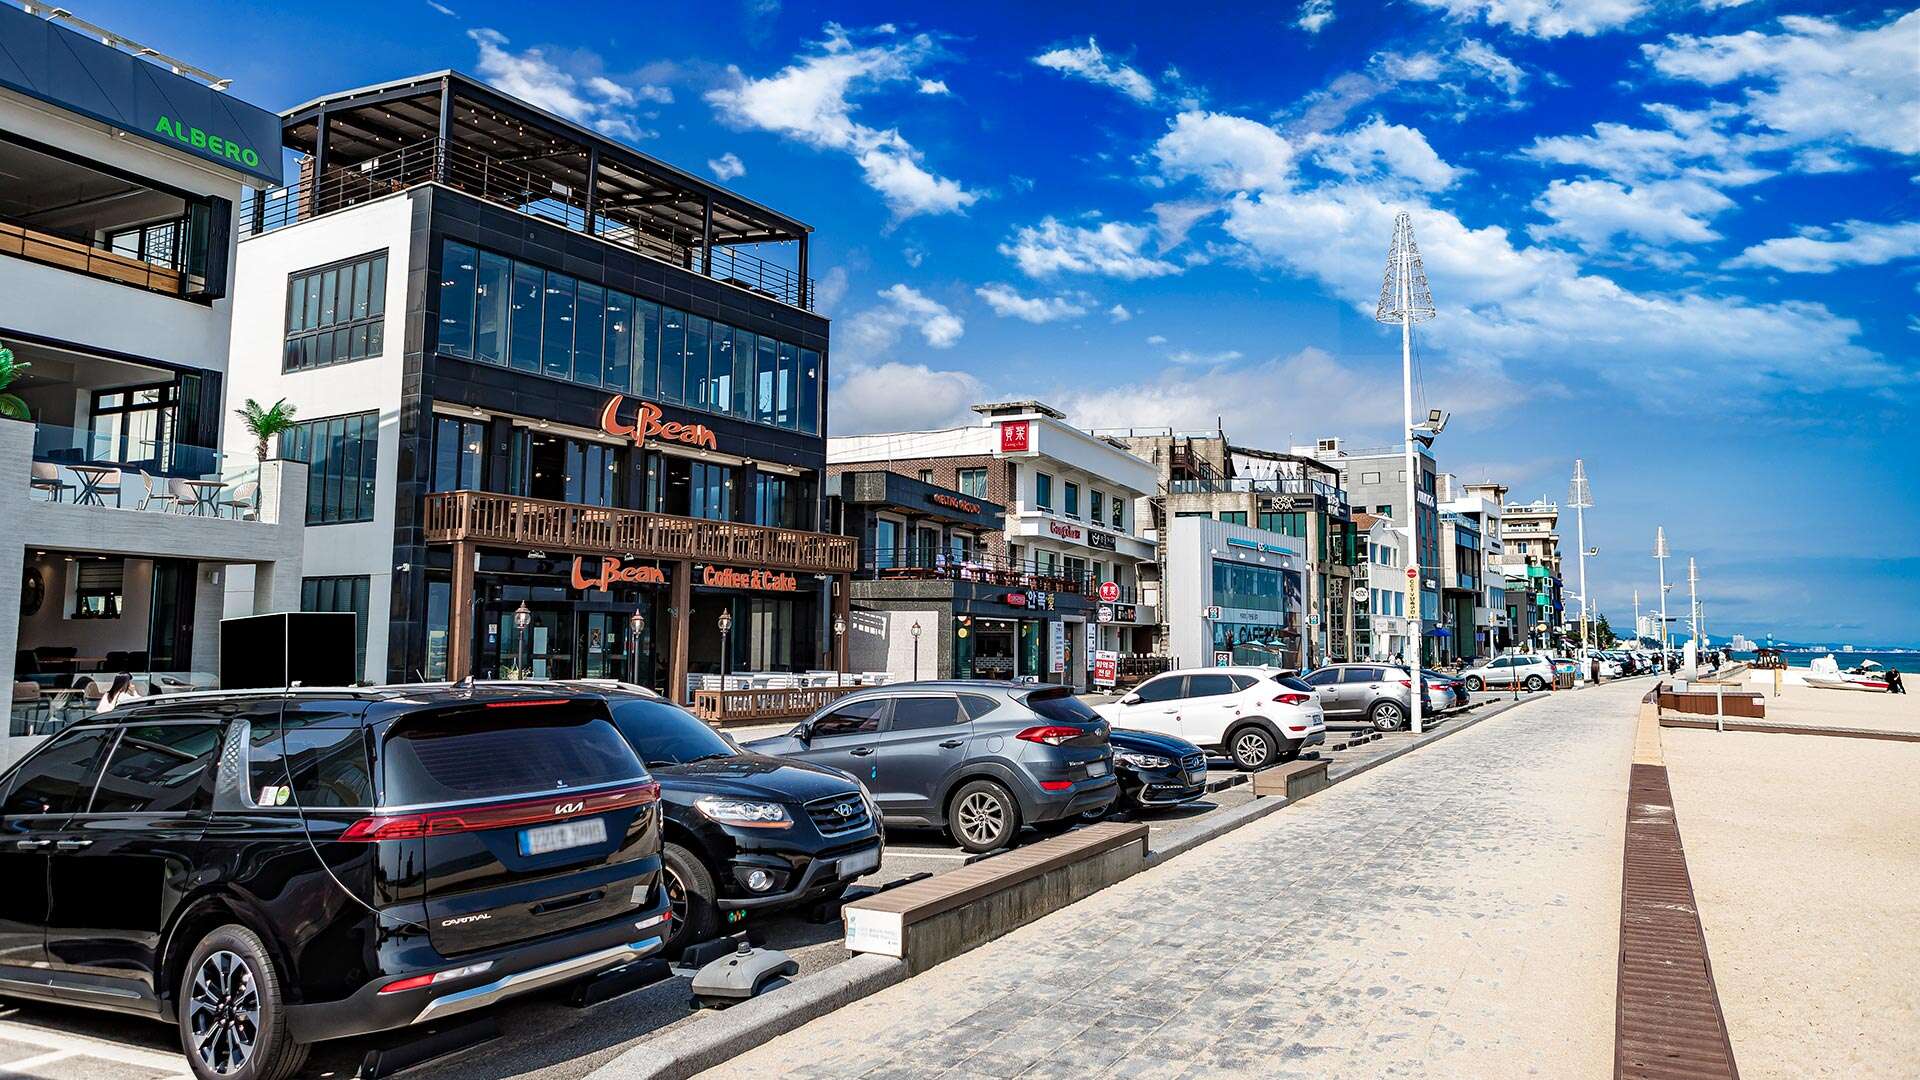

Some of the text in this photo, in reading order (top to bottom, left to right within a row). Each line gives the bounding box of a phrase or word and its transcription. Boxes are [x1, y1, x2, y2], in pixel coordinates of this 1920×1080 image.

[155, 116, 259, 167] ALBERO
[1271, 501, 1293, 510] NOVA
[704, 565, 796, 591] Coffee & Cake
[555, 802, 584, 815] KIA
